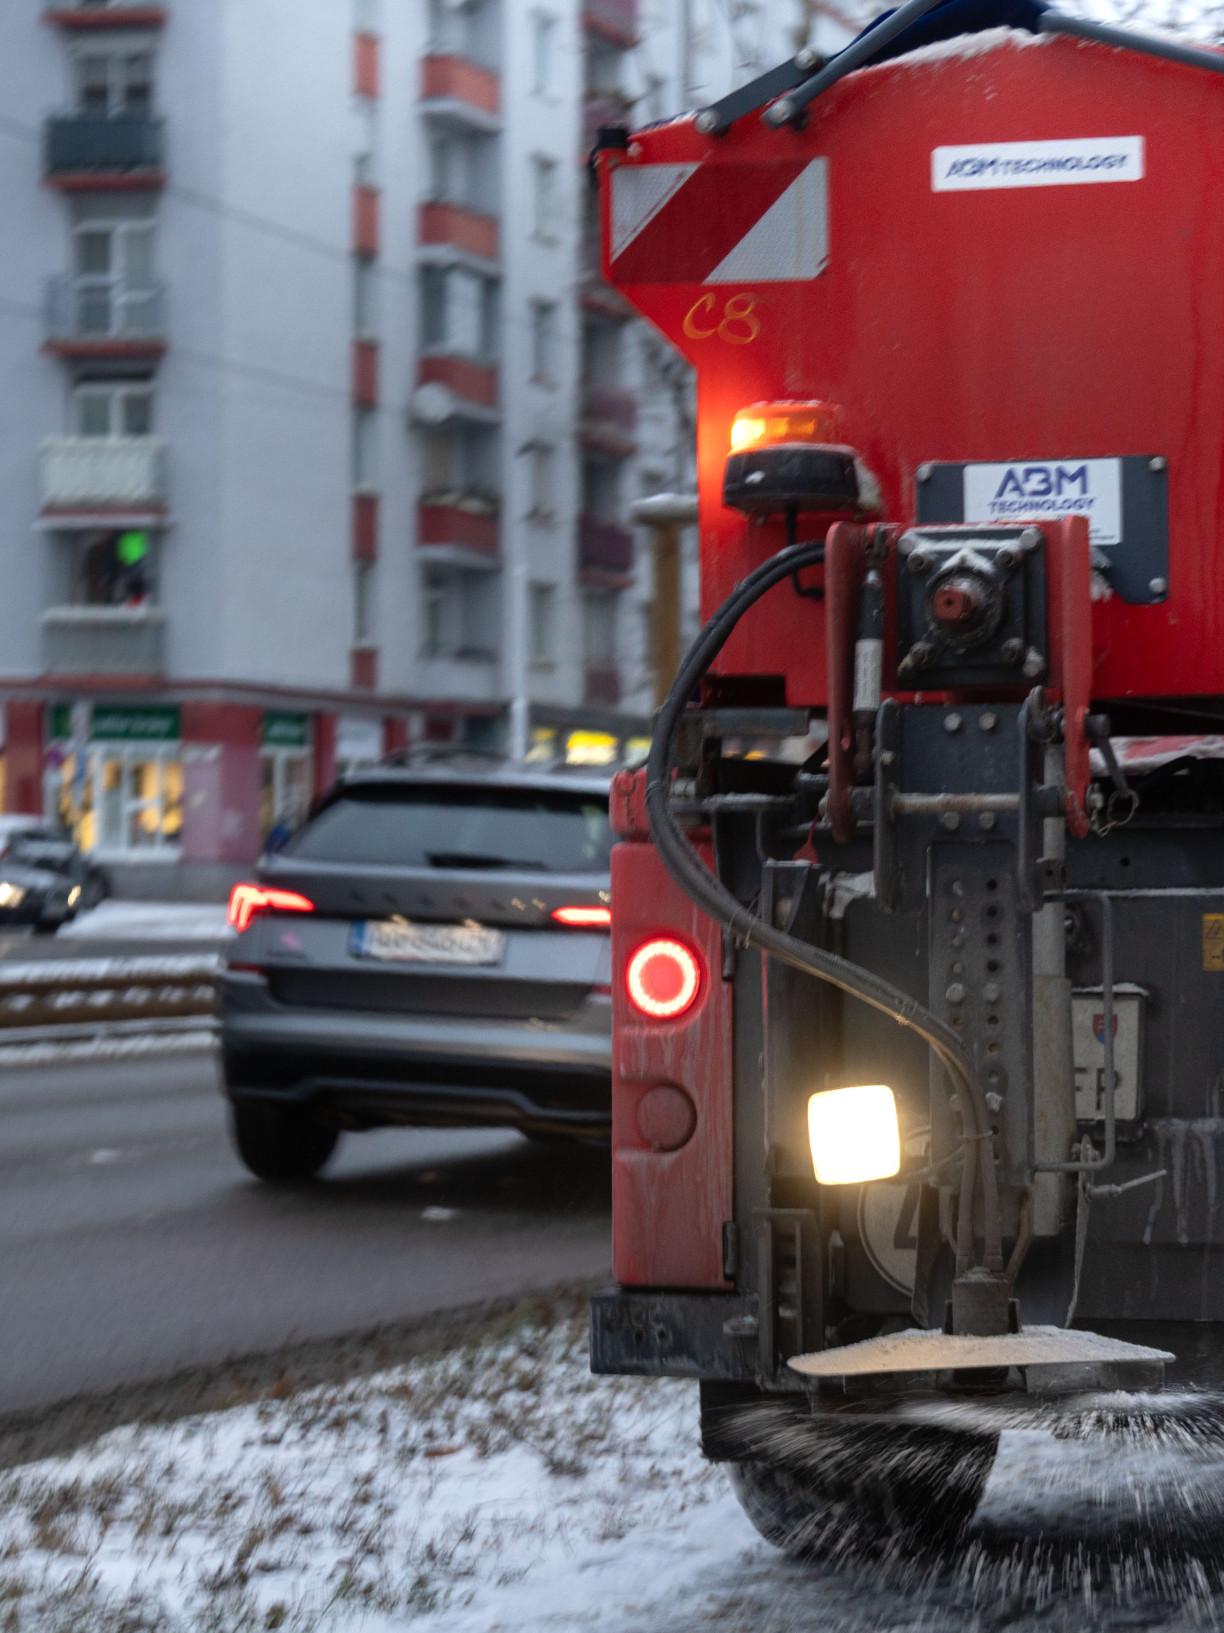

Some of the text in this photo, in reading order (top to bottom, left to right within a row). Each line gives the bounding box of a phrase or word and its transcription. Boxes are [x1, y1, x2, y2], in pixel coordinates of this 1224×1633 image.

[1000, 154, 1129, 175] TECHNOLOGY
[683, 292, 760, 344] C8
[988, 497, 1095, 513] TECHNOLOGY
